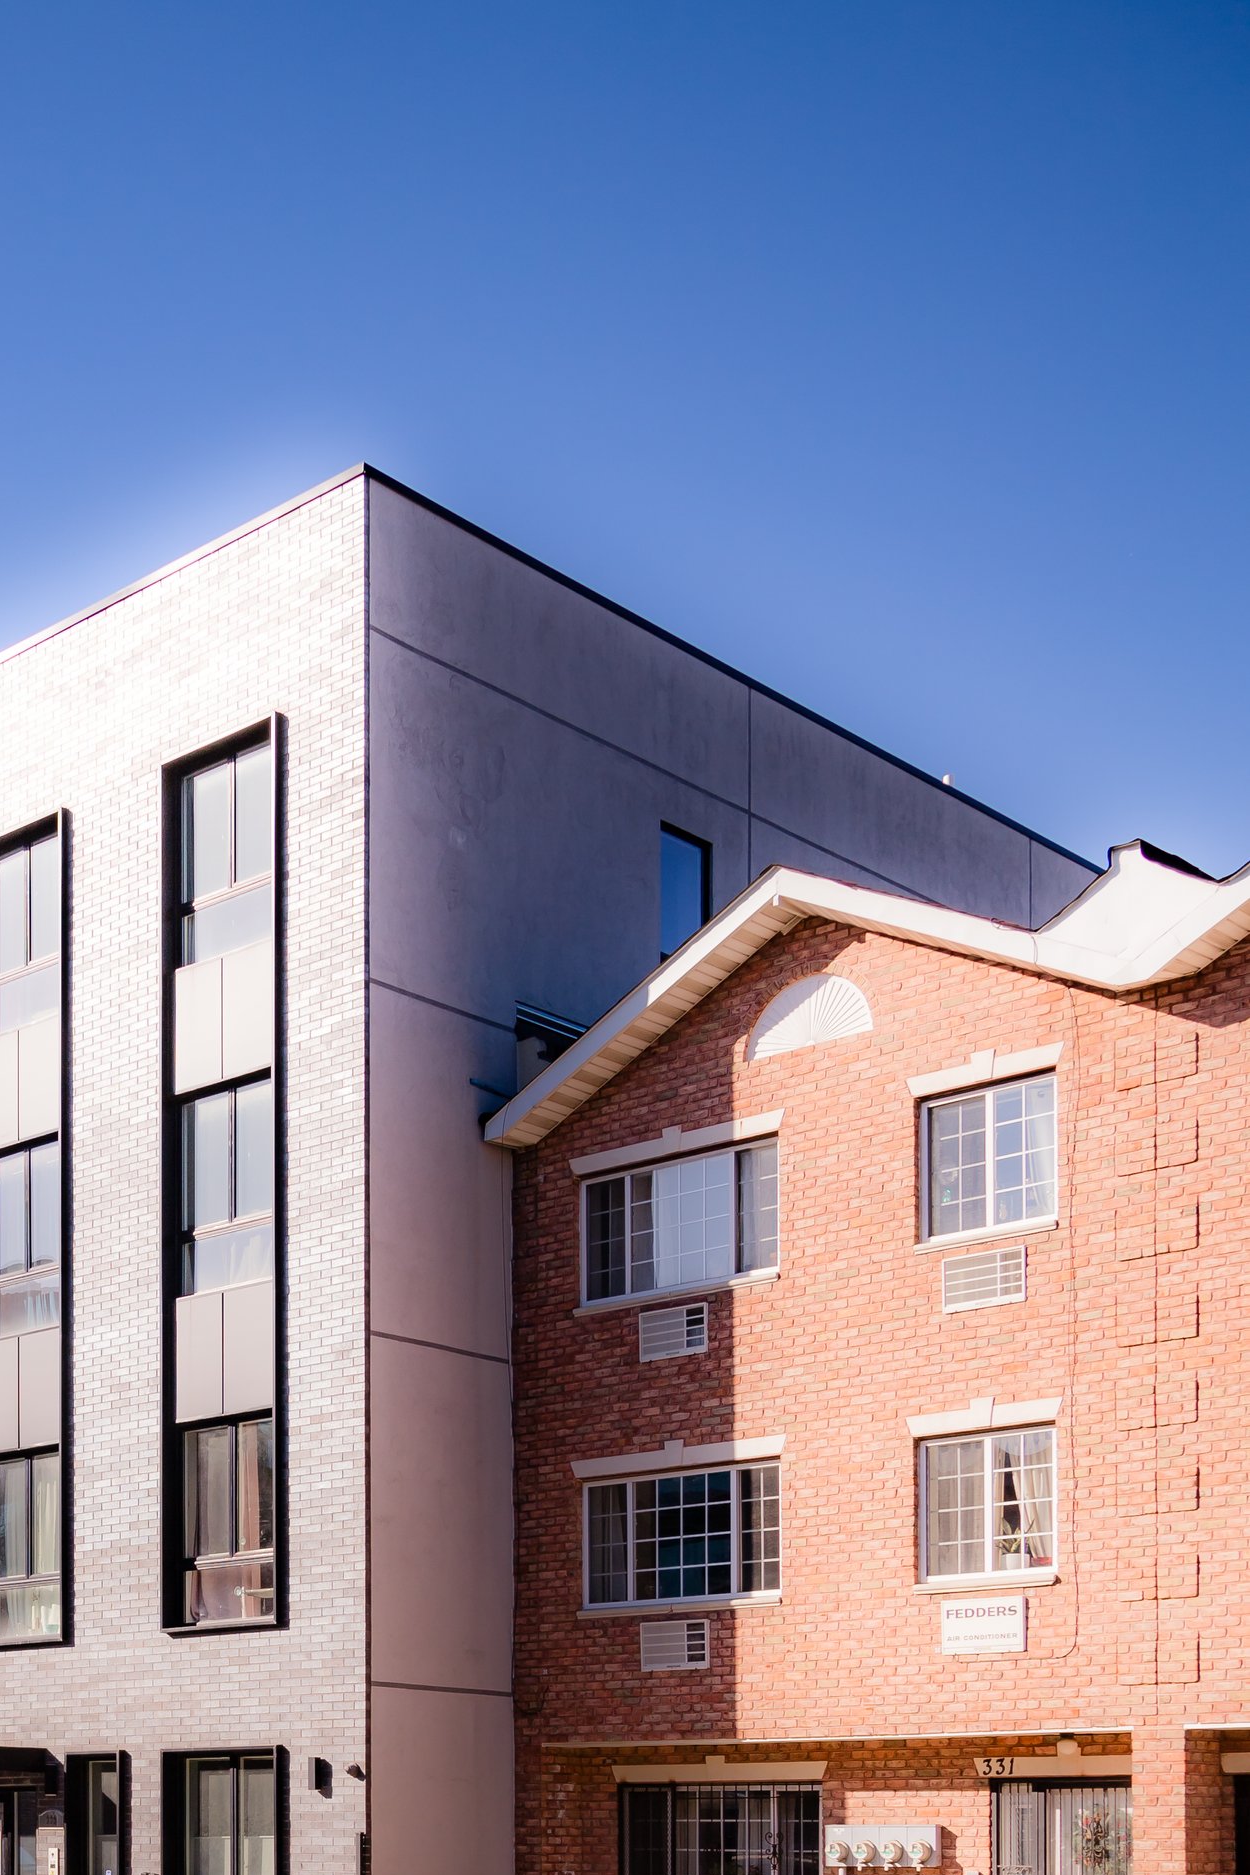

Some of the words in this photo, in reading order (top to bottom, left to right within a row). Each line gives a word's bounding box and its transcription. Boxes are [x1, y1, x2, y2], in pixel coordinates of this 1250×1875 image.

[946, 1605, 1018, 1619] FEDDERS
[963, 1632, 1018, 1641] CONDITIONER
[982, 1757, 1014, 1775] 331
